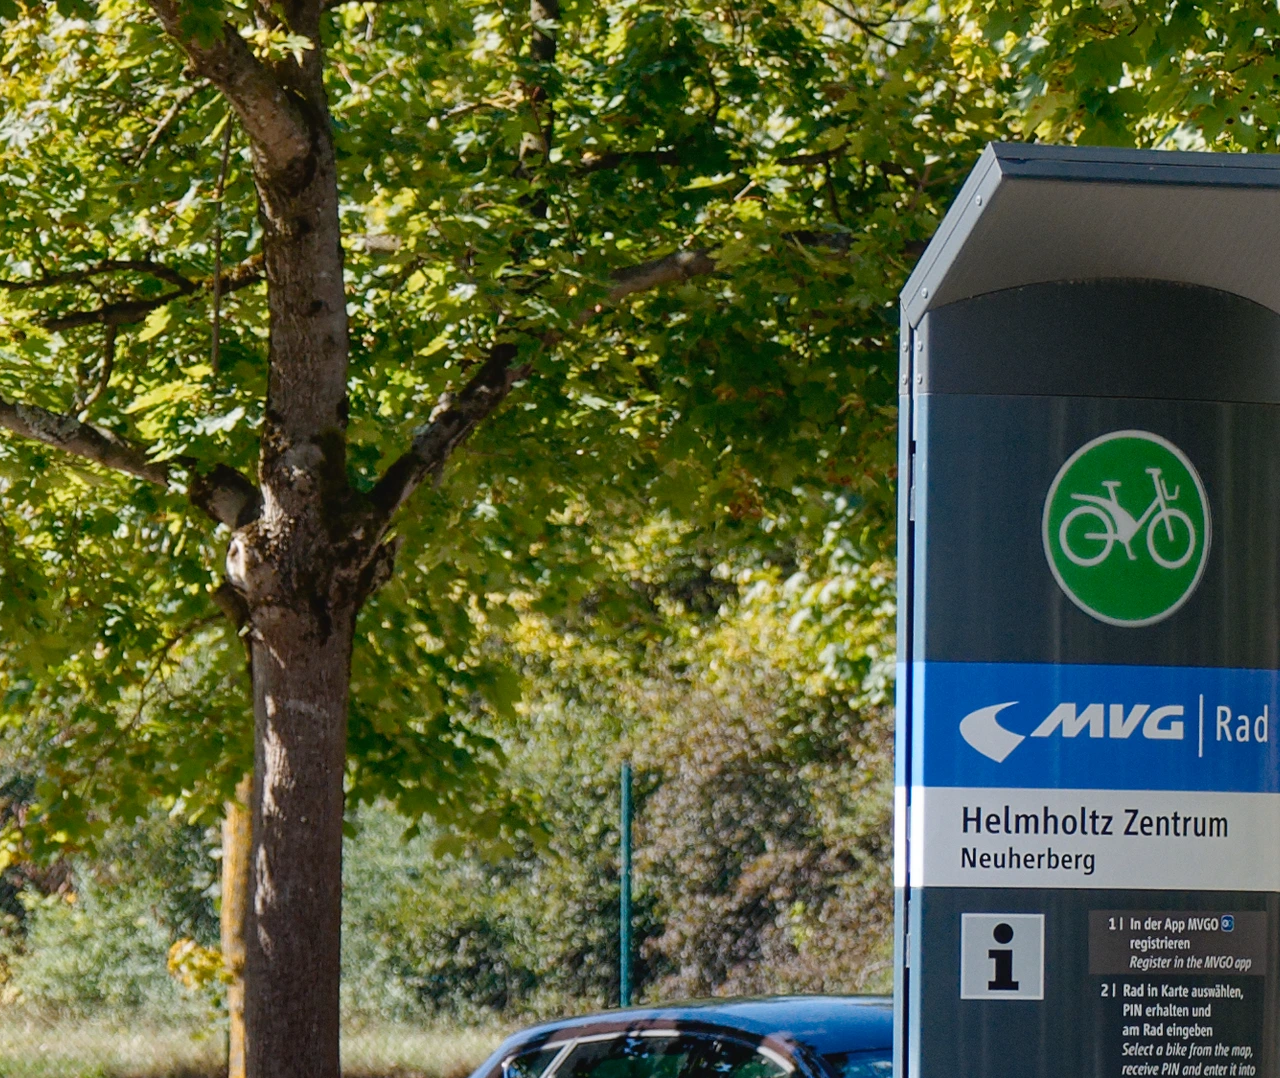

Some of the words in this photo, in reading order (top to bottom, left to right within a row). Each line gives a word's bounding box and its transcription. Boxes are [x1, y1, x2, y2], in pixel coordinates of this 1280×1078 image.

[1030, 703, 1184, 740] MVG
[1217, 705, 1268, 743] Rad
[962, 806, 1113, 835] Helmholtz
[1124, 809, 1228, 837] Zentrum
[961, 847, 1095, 875] Neuherberg
[1130, 918, 1142, 930] In
[1145, 918, 1161, 931] der
[1164, 918, 1185, 934] App
[1188, 918, 1218, 931] MVGO
[1130, 937, 1190, 952] registrieren
[1130, 956, 1171, 971] Register
[1174, 956, 1184, 968] in
[1186, 956, 1202, 968] the
[1204, 956, 1233, 969] MVGO
[1235, 960, 1251, 972] app
[1123, 985, 1144, 997] Rad
[1147, 985, 1158, 997] in
[1162, 985, 1188, 998] Karte
[1192, 985, 1243, 999] auswählen,
[1123, 1004, 1142, 1016] PIN
[1146, 1004, 1189, 1017] erhalten
[1192, 1004, 1211, 1017] und
[1122, 1027, 1139, 1036] am
[1143, 1024, 1163, 1036] Rad
[1167, 1024, 1213, 1039] eingeben
[1122, 1043, 1153, 1056] Select
[1156, 1046, 1163, 1056] a
[1167, 1043, 1186, 1056] bike
[1188, 1043, 1211, 1059] from
[1215, 1044, 1229, 1057] the
[1231, 1046, 1253, 1059] map,
[1122, 1064, 1158, 1076] receive
[1162, 1063, 1179, 1076] PIN
[1182, 1063, 1201, 1076] and
[1204, 1064, 1227, 1076] enter
[1230, 1064, 1236, 1076] it
[1239, 1064, 1256, 1076] into
